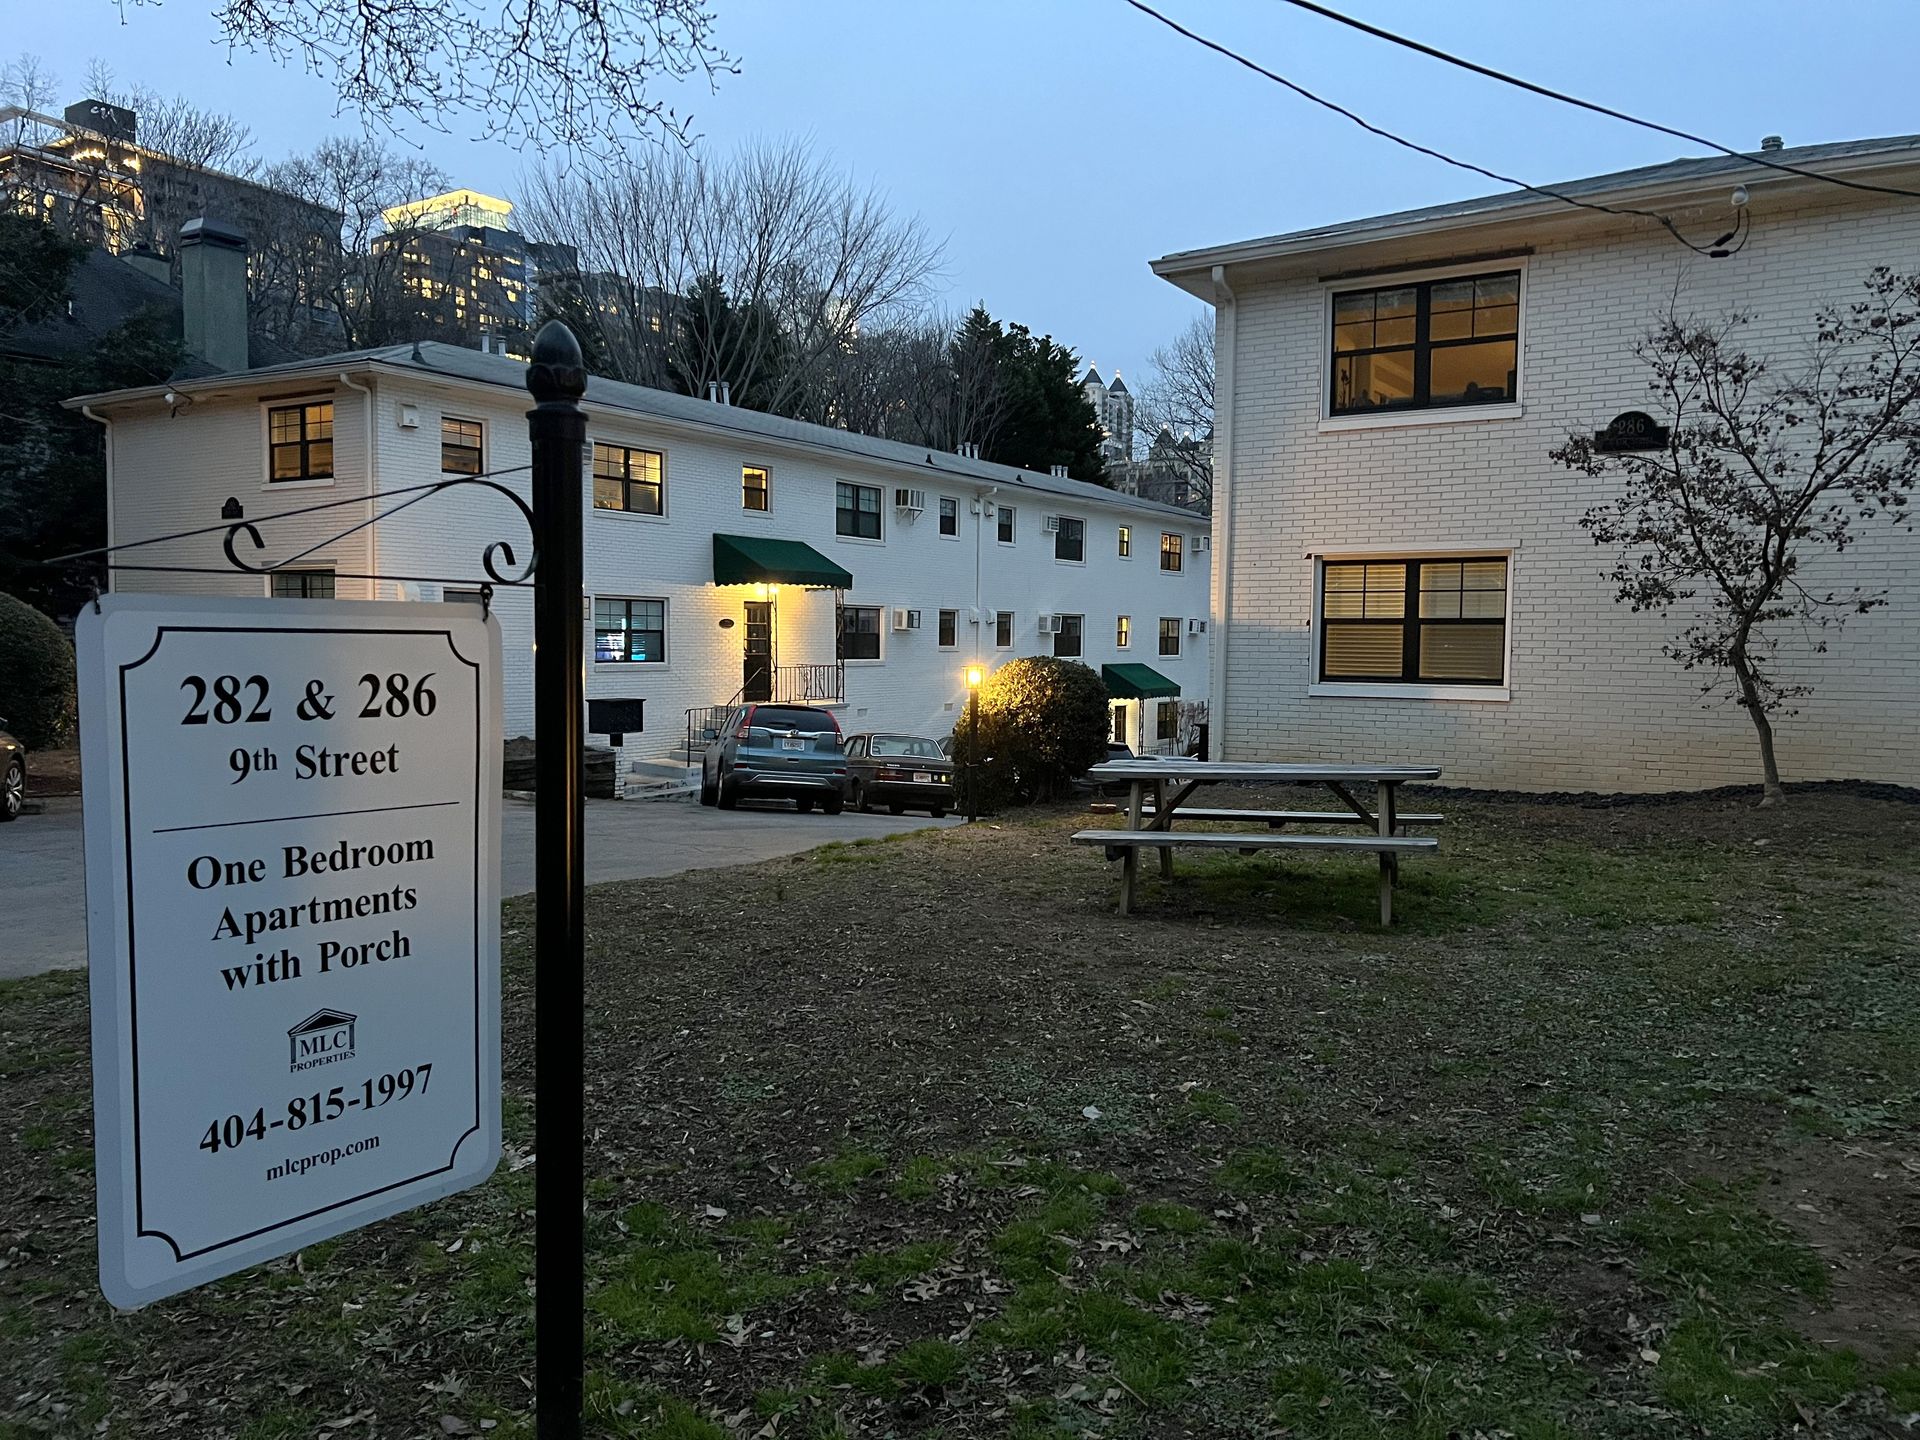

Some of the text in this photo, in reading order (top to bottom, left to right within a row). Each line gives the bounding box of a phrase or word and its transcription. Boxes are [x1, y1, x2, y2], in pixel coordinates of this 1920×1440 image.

[180, 672, 437, 725] 282 & 286
[229, 743, 400, 785] 9th Street
[187, 838, 435, 890] One Bedroom
[211, 883, 417, 945] Apartments
[220, 930, 411, 991] with Porch
[290, 1049, 356, 1073] PROPERTIES
[300, 1030, 347, 1057] MLC
[199, 1063, 433, 1154] 404-815-1997
[265, 1135, 381, 1181] mlcprop.com
